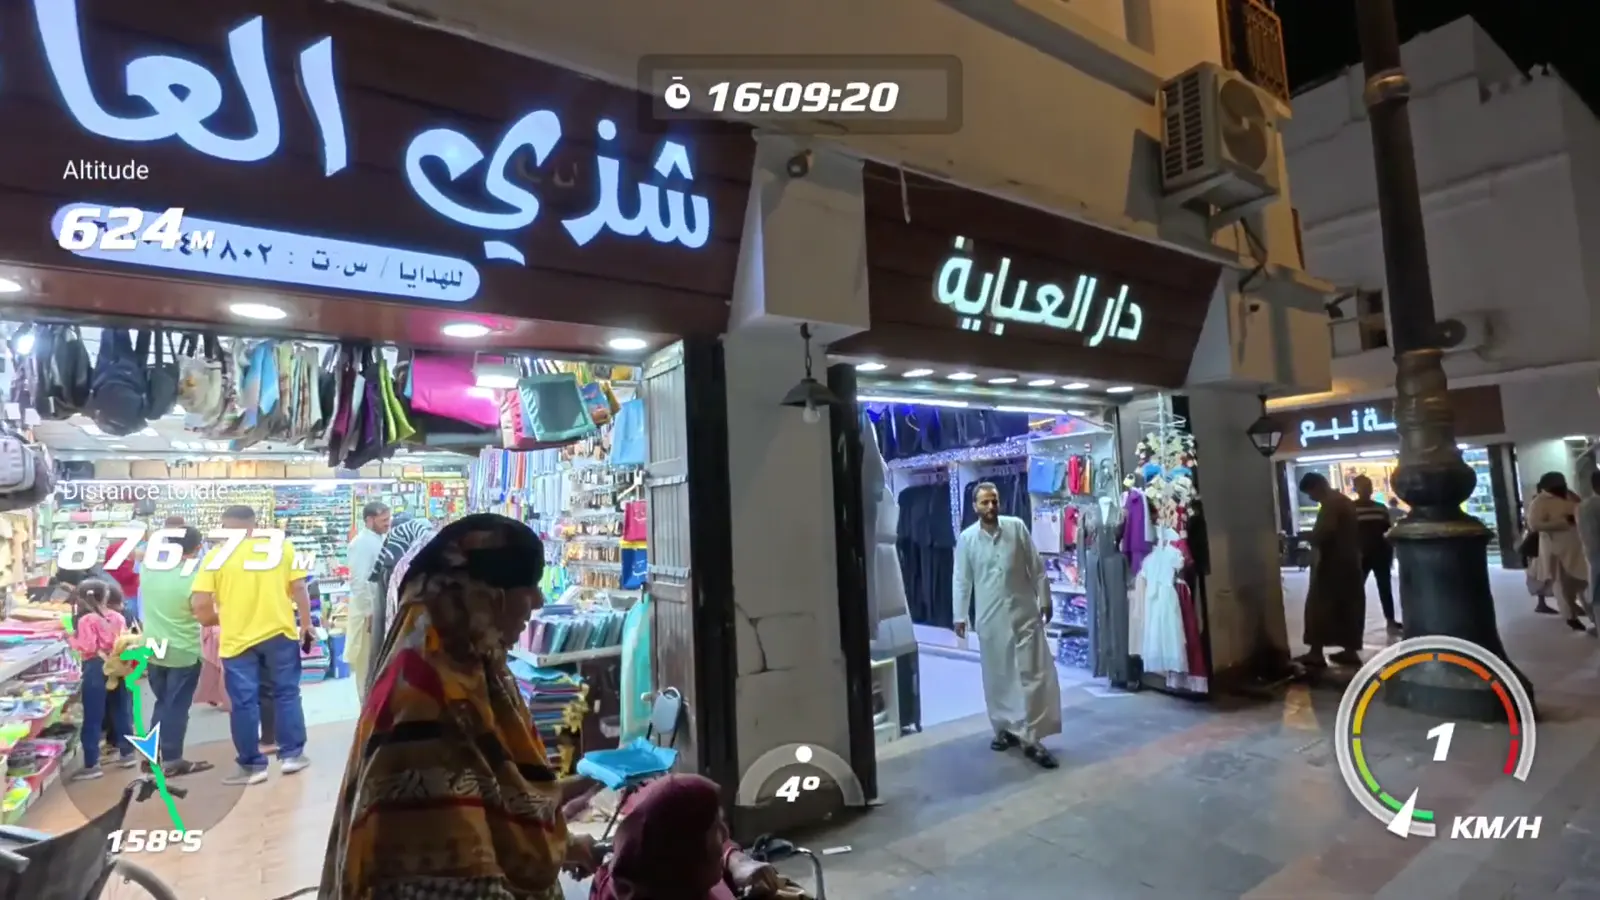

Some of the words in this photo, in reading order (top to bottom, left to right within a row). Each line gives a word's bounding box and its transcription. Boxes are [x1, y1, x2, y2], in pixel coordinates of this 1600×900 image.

[400, 261, 464, 290] للهدايا
[936, 235, 1097, 336] العباية
[1089, 284, 1143, 347] دار
[1300, 409, 1360, 448] نبع
